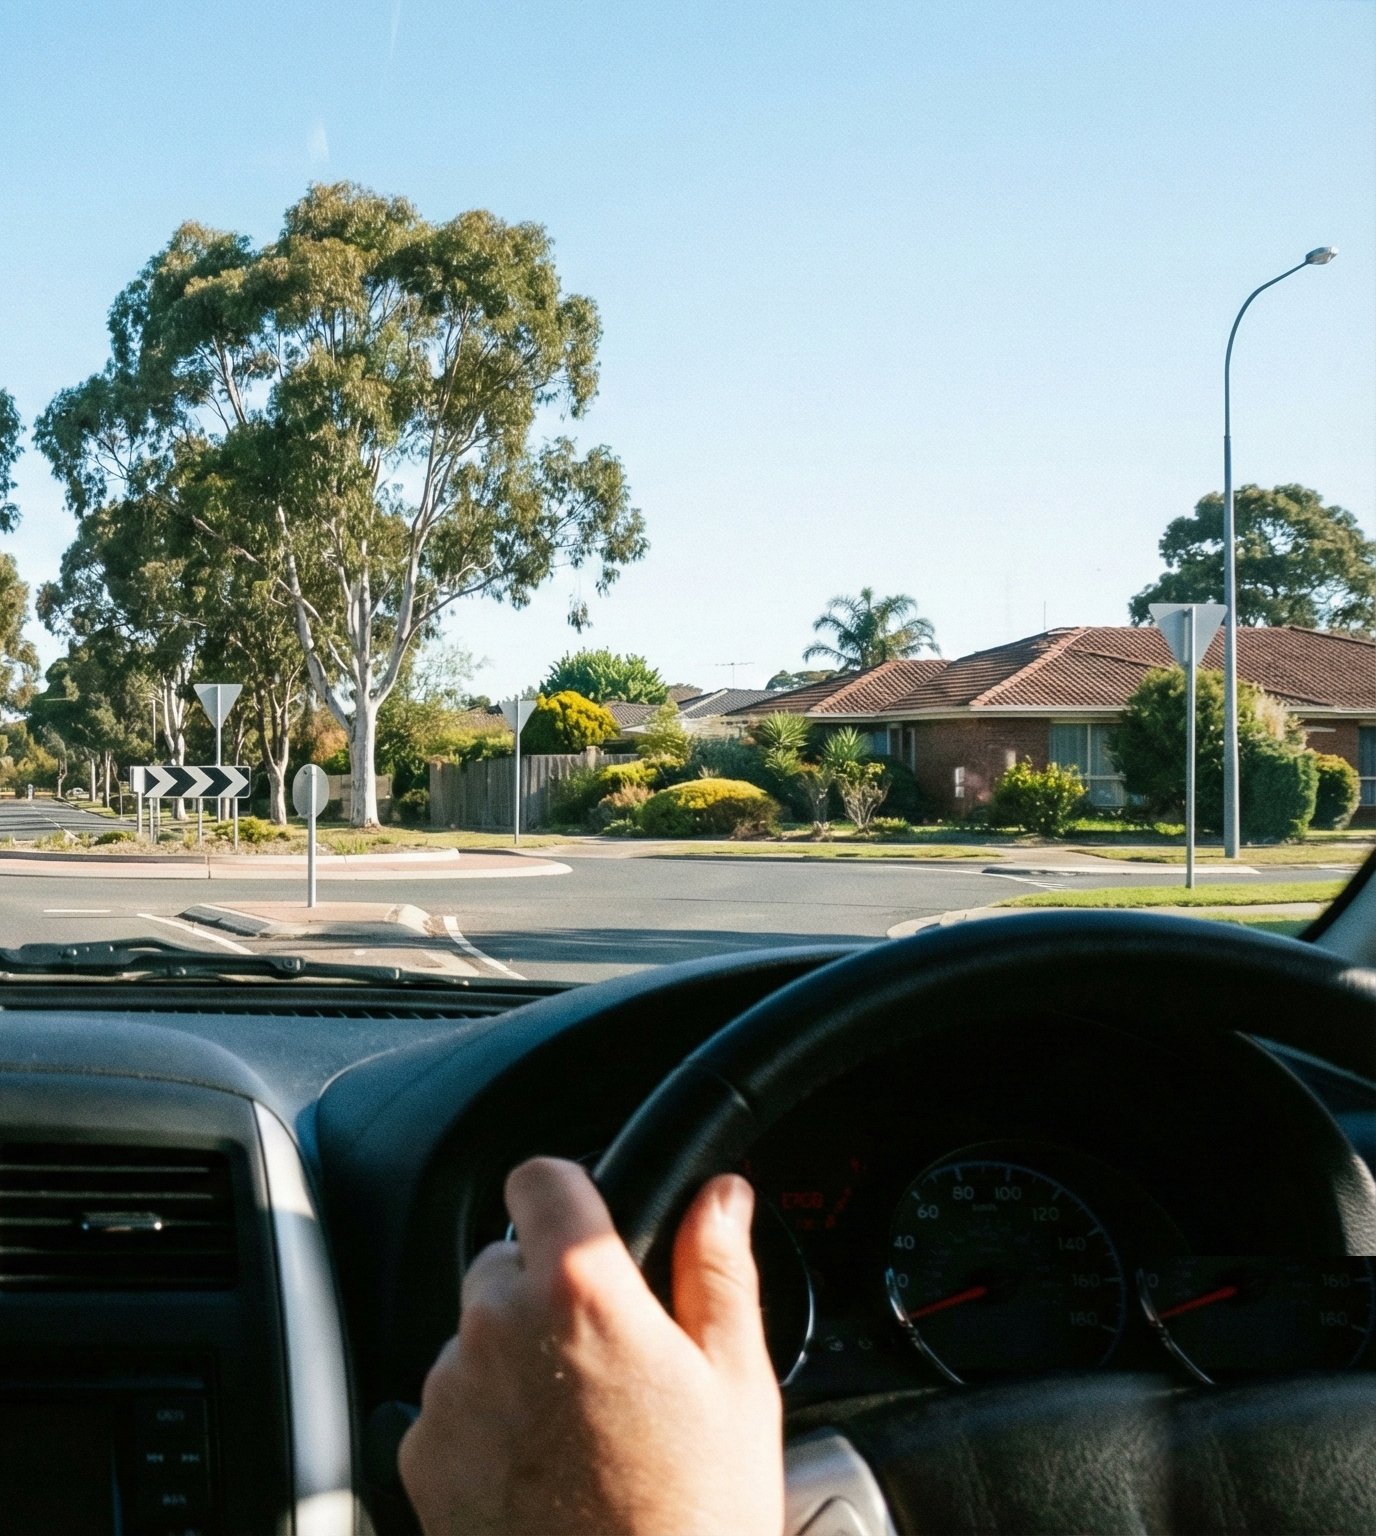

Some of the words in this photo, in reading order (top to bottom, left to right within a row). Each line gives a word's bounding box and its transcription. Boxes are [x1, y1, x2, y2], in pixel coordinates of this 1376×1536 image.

[952, 1186, 975, 1200] 80
[994, 1186, 1022, 1200] 100
[917, 1204, 939, 1220] 60
[1032, 1207, 1060, 1222] 120
[893, 1235, 915, 1250] 40
[1058, 1237, 1087, 1252] 140
[1071, 1273, 1100, 1288] 160
